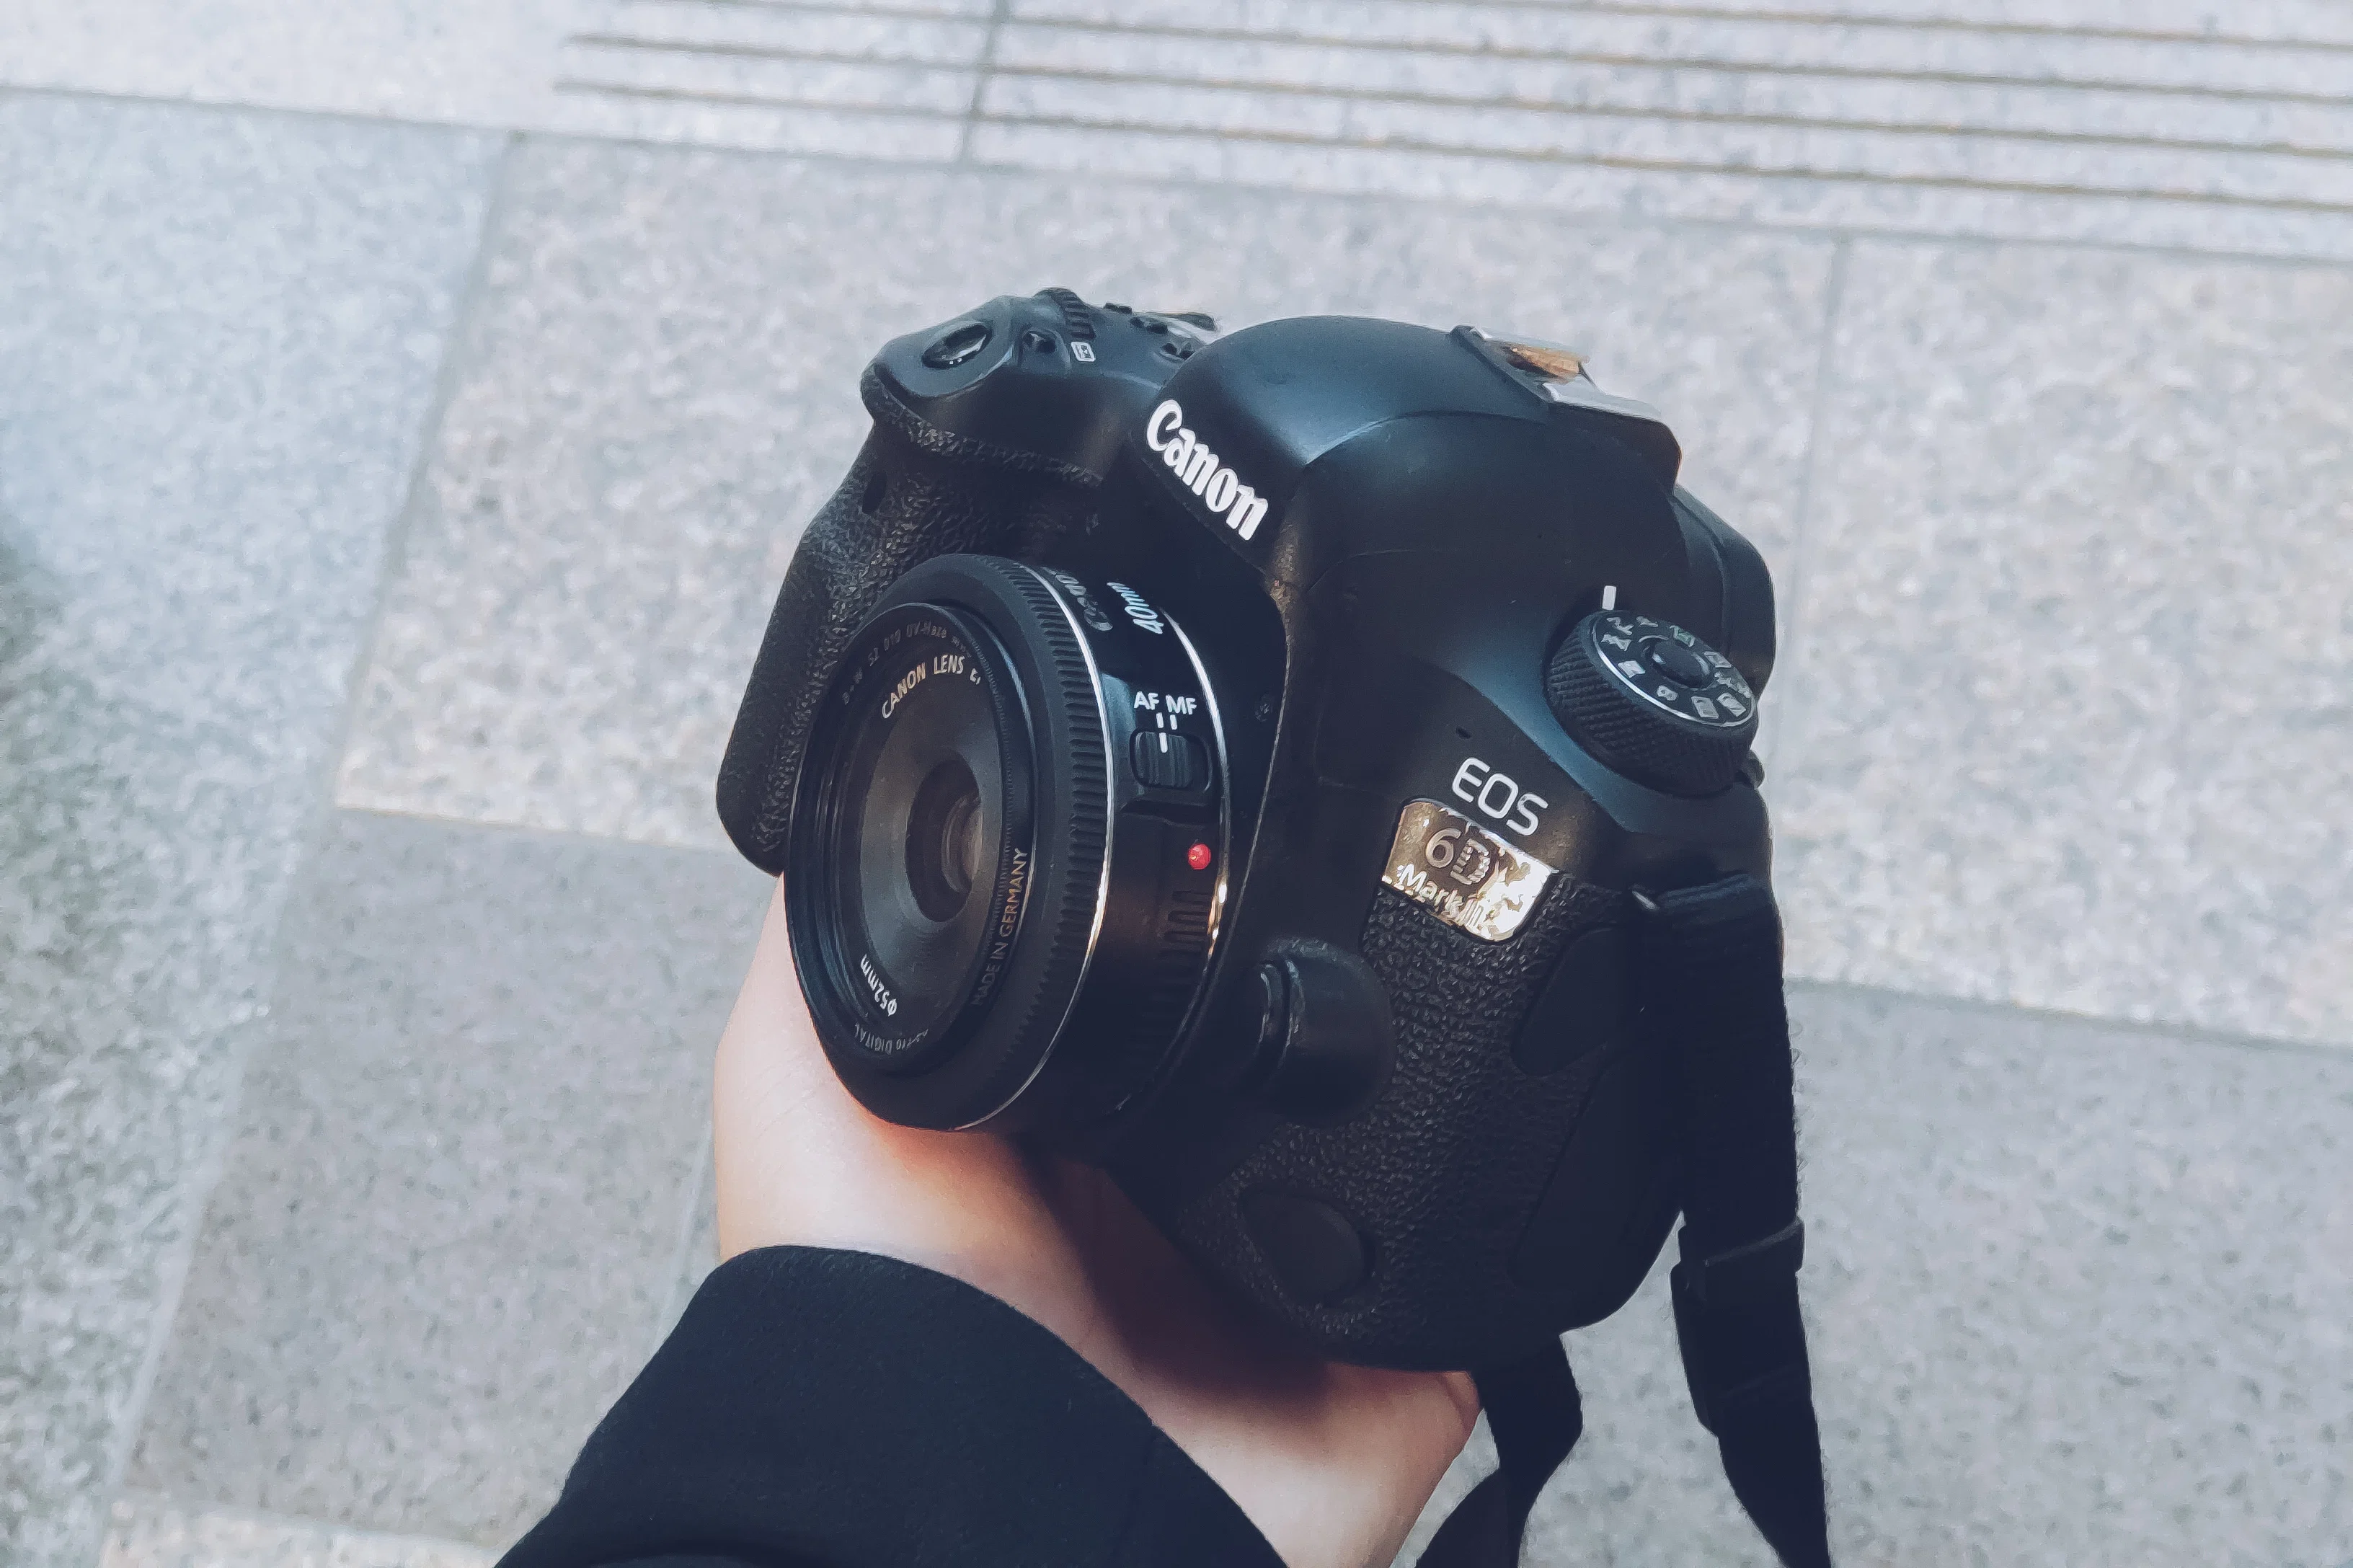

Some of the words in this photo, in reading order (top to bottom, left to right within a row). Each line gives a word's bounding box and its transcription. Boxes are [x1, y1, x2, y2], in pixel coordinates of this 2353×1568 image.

[1147, 399, 1269, 541] Canon
[1107, 582, 1164, 634] 40mm
[882, 662, 927, 719] CANON
[934, 654, 965, 675] LENS
[1134, 691, 1160, 710] AF
[1165, 694, 1197, 715] MF
[1452, 758, 1549, 836] EOS
[1425, 828, 1491, 885] 6D
[998, 848, 1028, 937] GERMANY
[1397, 864, 1464, 920] Mark
[990, 942, 1009, 960] IN
[971, 963, 1001, 1005] MADE
[855, 1022, 893, 1055] DIGITAL
